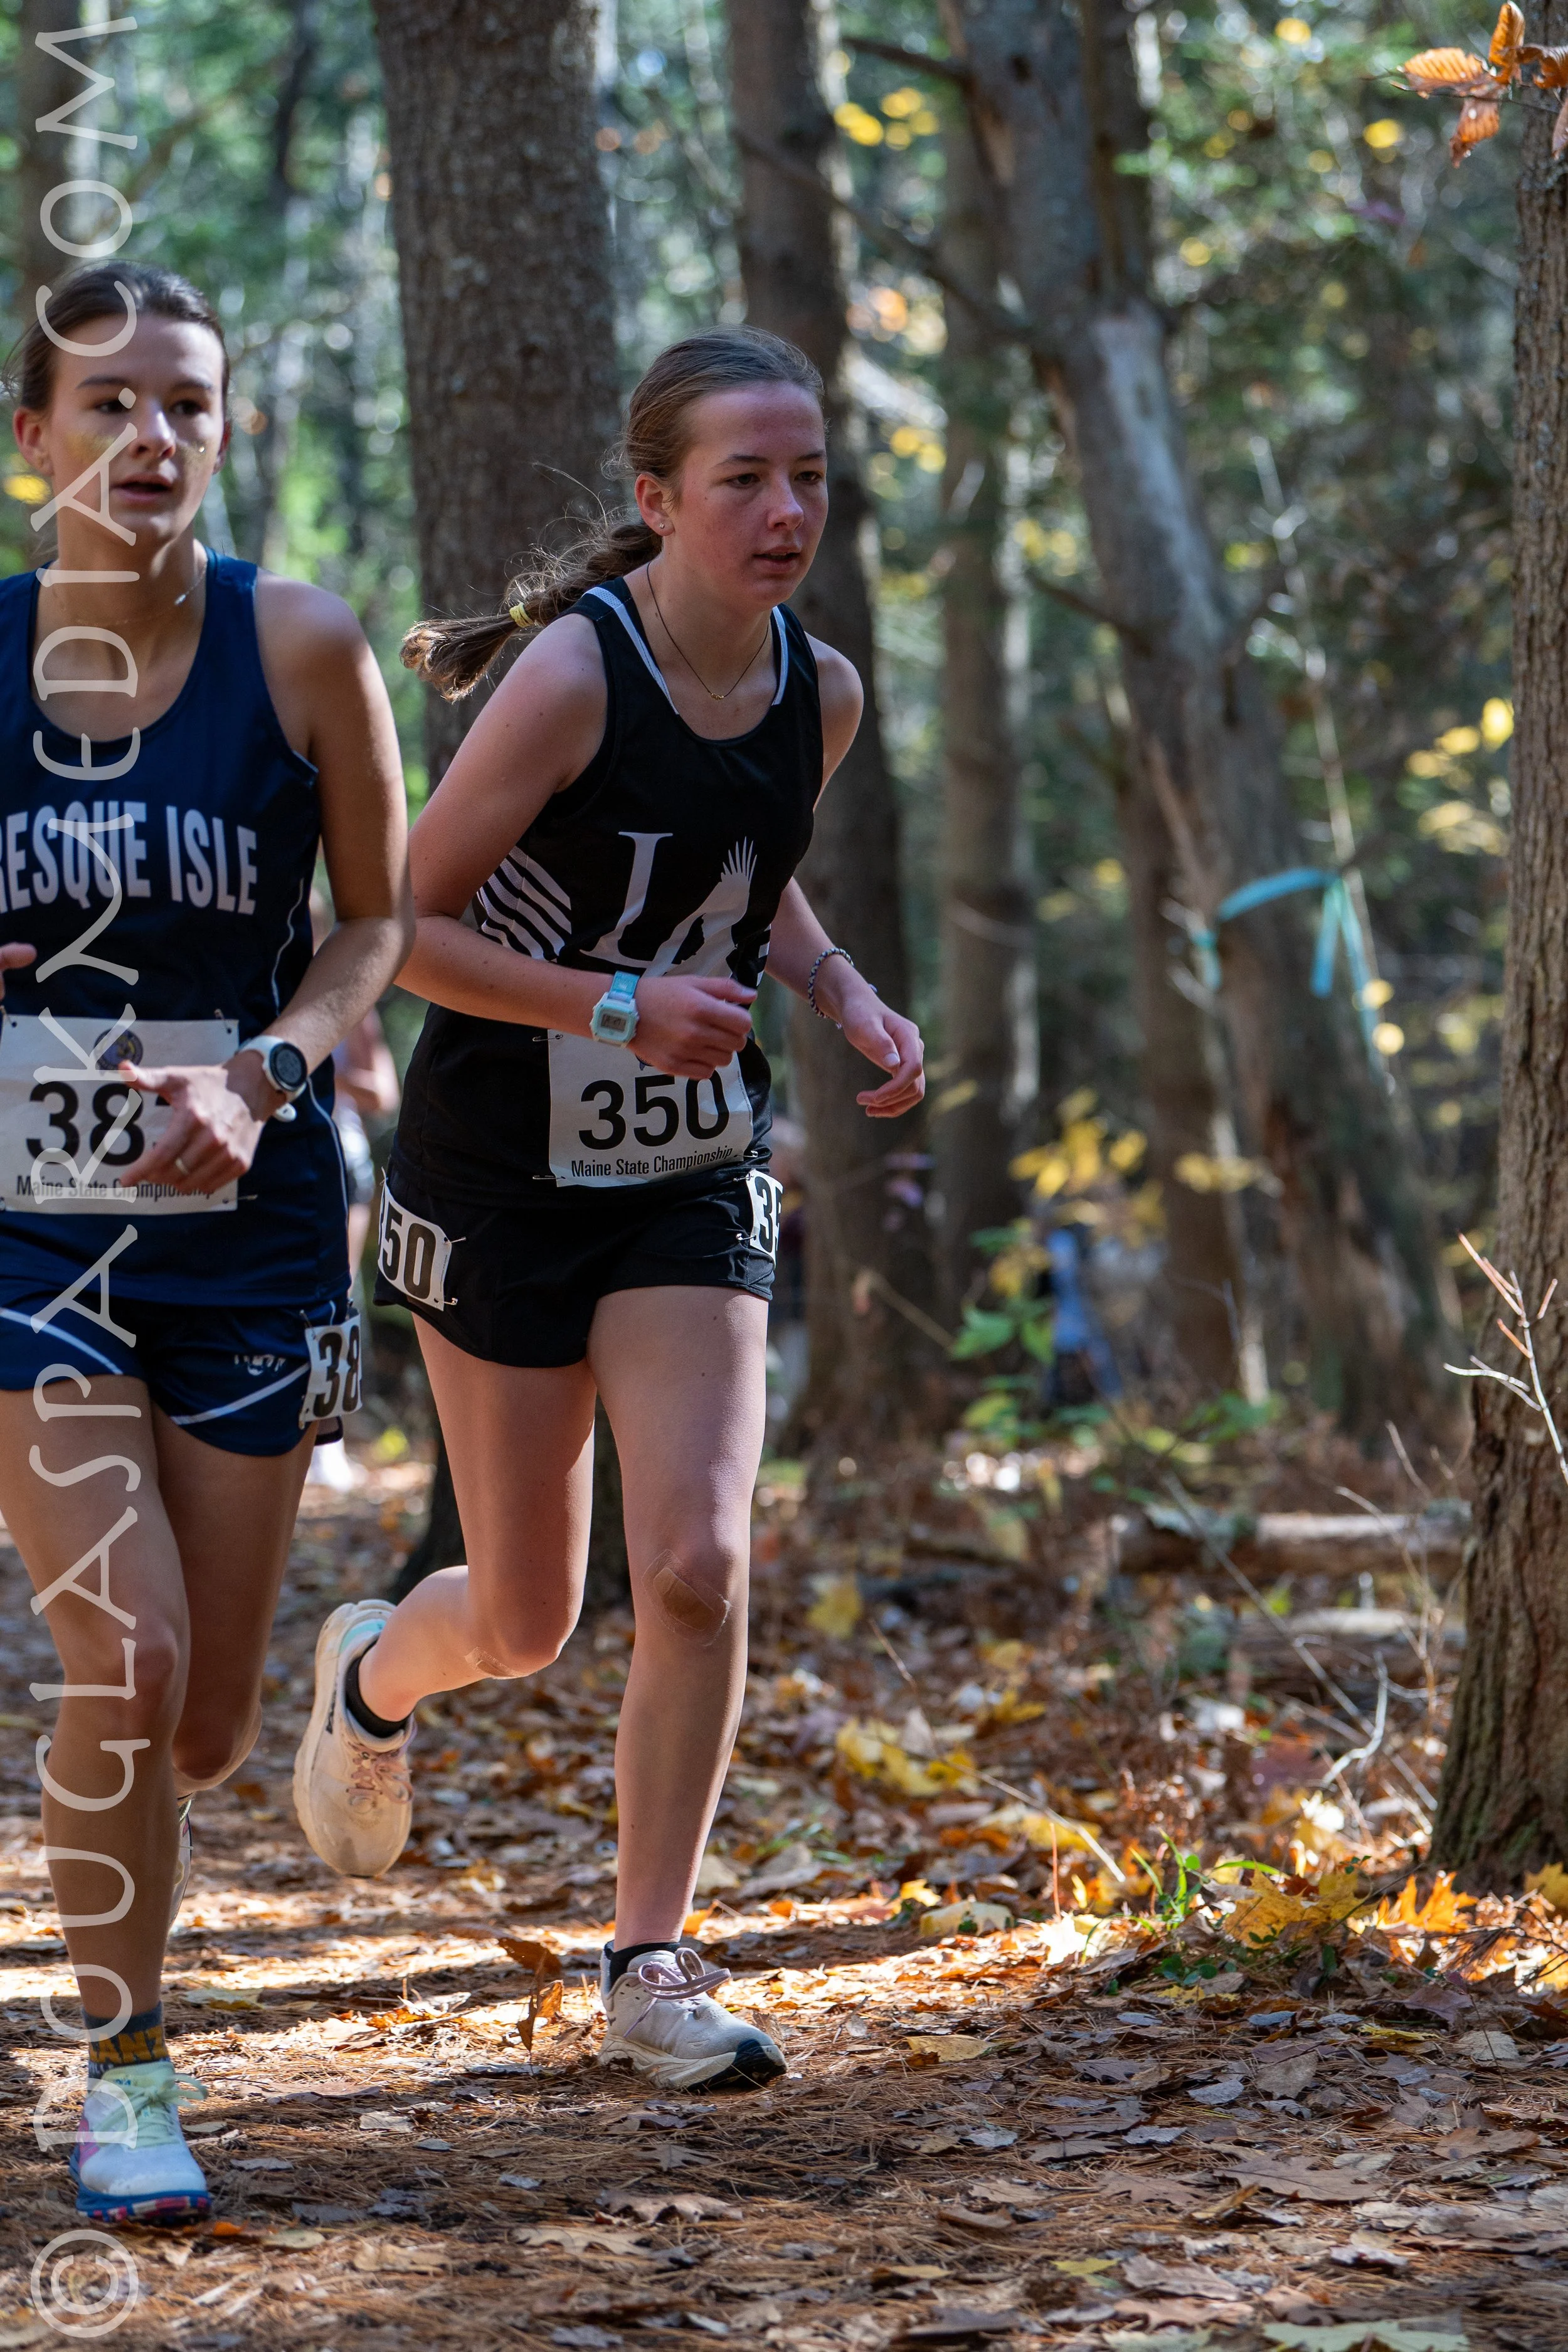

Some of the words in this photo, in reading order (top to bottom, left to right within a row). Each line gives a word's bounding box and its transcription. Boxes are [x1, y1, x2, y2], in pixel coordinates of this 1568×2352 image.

[0, 800, 151, 914] ESQUE
[166, 805, 258, 916] ISLE
[578, 1069, 730, 1150] 350
[17, 1175, 63, 1197] Maine
[69, 1177, 107, 1197] State
[571, 1160, 612, 1177] Maine
[616, 1159, 650, 1175] State
[654, 1146, 733, 1173] Championship
